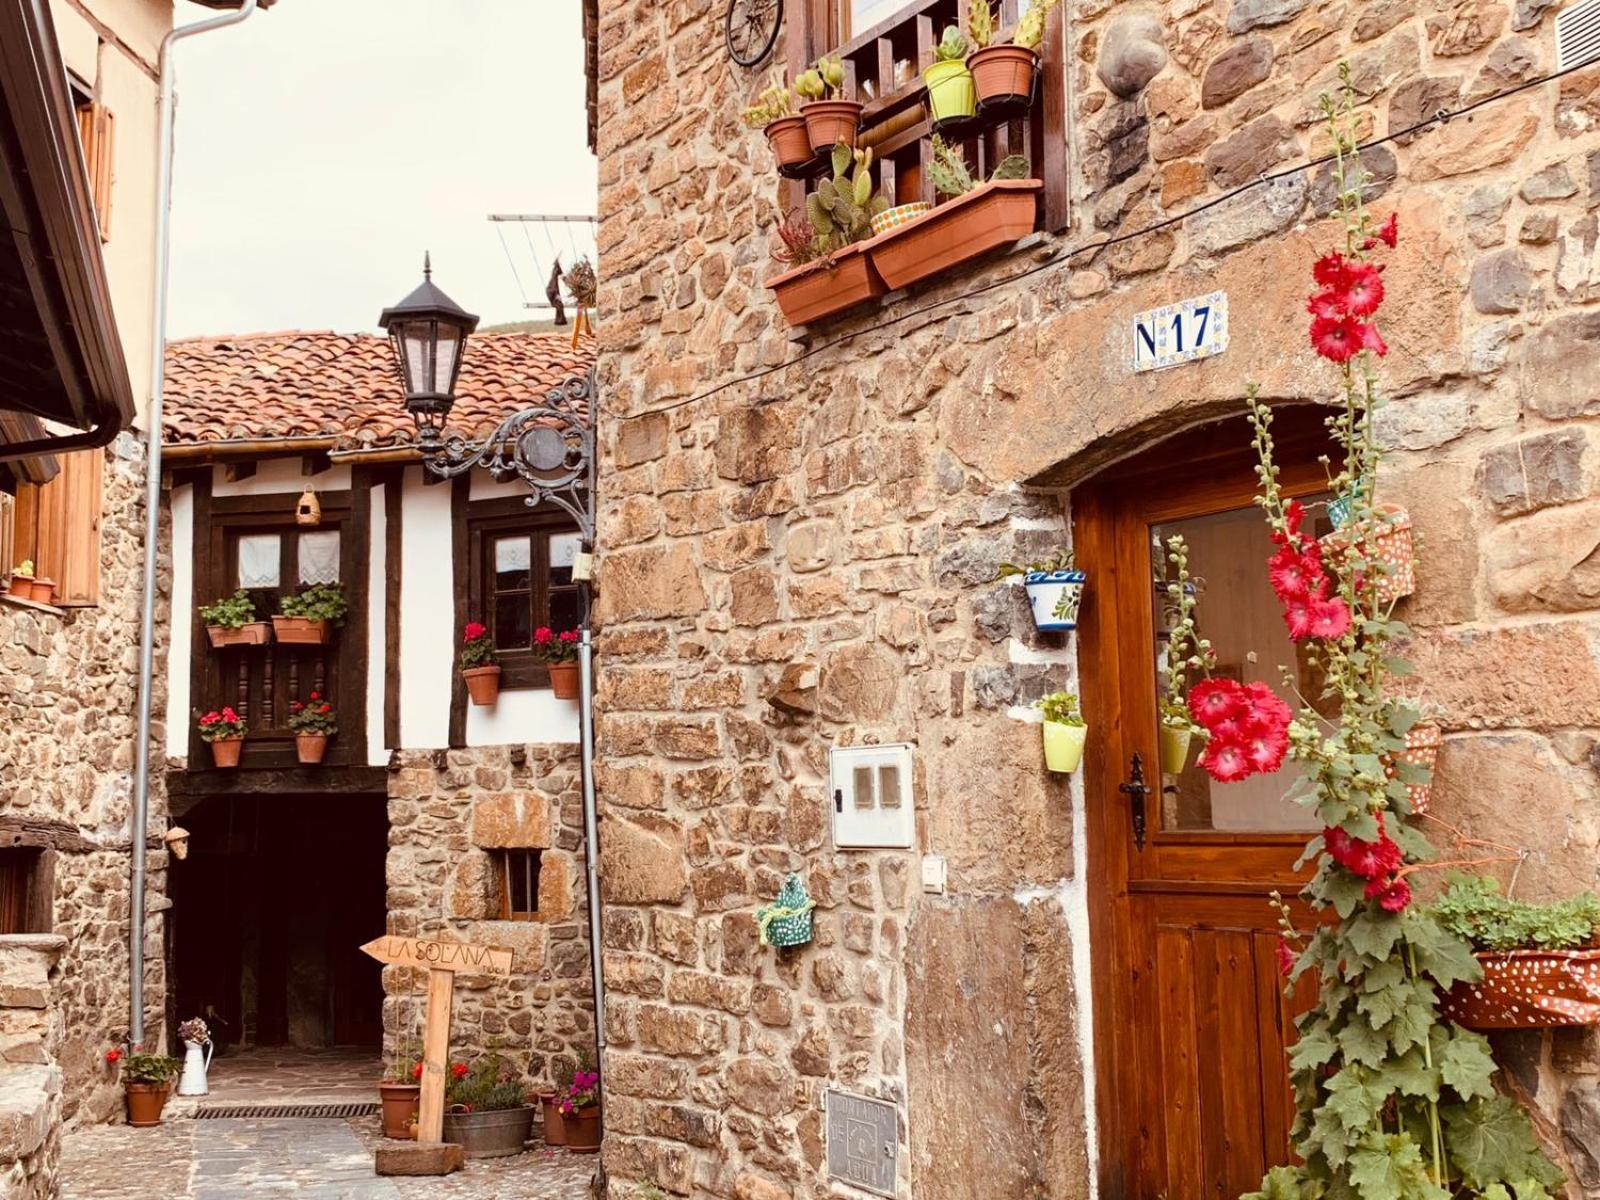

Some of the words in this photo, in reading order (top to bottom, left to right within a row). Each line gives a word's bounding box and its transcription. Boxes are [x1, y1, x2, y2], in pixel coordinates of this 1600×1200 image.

[1170, 306, 1210, 353] 17
[387, 940, 410, 959] LA
[415, 940, 495, 966] SOLANA
